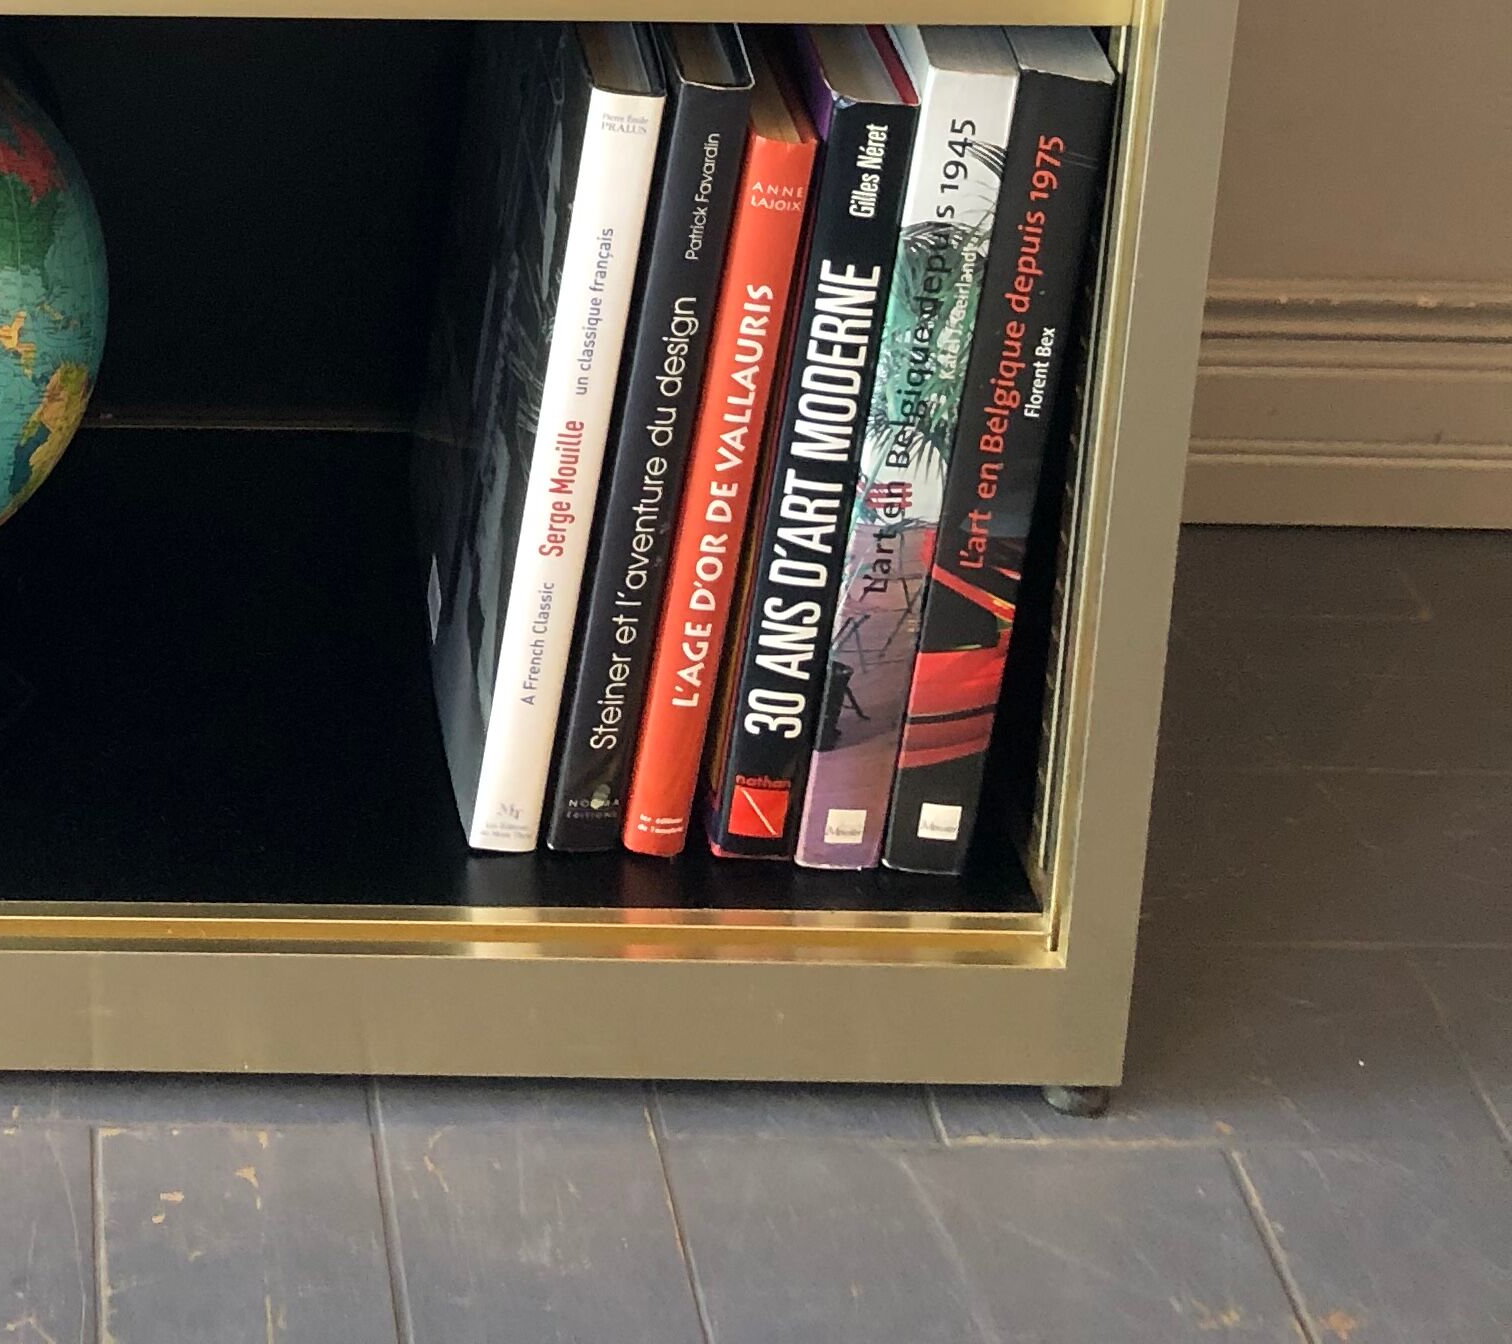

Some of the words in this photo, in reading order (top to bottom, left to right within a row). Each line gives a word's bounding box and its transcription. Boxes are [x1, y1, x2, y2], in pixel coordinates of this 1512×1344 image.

[695, 132, 721, 203] Favardin
[856, 122, 890, 175] Néret
[940, 119, 977, 194] 1945
[1030, 135, 1065, 201] 1975
[751, 194, 803, 212] LAJOIX
[752, 181, 804, 198] ANNE
[848, 172, 880, 220] Gilles
[589, 227, 615, 293] français
[685, 202, 709, 261] Patrick
[1004, 210, 1046, 314] depuis
[577, 296, 604, 372] classique
[656, 296, 700, 397] design
[790, 258, 882, 461] MODERNE
[1035, 327, 1056, 358] Bex
[575, 375, 589, 396] un
[715, 283, 774, 473] VALLAURIS
[885, 322, 934, 469] Belgique
[980, 320, 1026, 454] Belgique
[1023, 359, 1050, 418] Florent
[549, 420, 585, 495] Mouille
[646, 406, 678, 448] du
[705, 481, 738, 524] DE
[882, 480, 907, 518] en
[977, 462, 1005, 500] en
[538, 500, 575, 558] Serge
[615, 456, 668, 607] l'aventure
[768, 468, 844, 588] D'ART
[960, 509, 992, 571] L'art
[689, 532, 729, 612] D'OR
[862, 528, 897, 594] L'art
[532, 582, 555, 634] Classic
[611, 614, 639, 645] et
[522, 638, 545, 691] French
[671, 620, 713, 709] L'AGE
[755, 597, 822, 682] ANS
[520, 694, 536, 706] A
[589, 652, 632, 750] Steiner
[744, 687, 807, 739] 30
[735, 774, 792, 789] nathan
